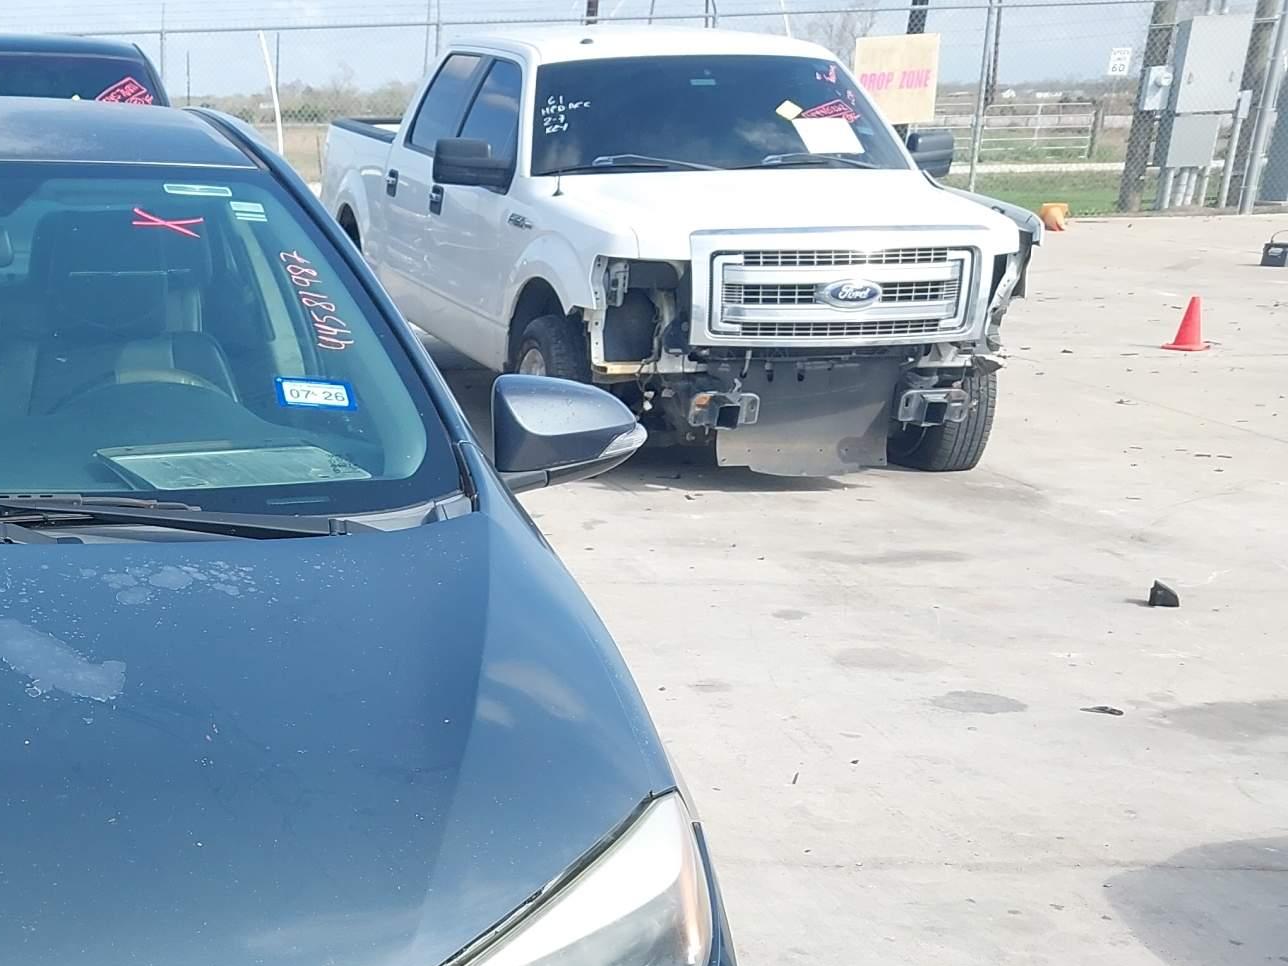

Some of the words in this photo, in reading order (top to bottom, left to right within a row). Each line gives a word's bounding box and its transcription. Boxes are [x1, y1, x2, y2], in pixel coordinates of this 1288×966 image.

[1111, 63, 1125, 72] 60
[859, 72, 895, 92] DROP
[898, 69, 932, 89] ZONE
[279, 250, 355, 350] 44581987
[838, 284, 871, 300] Ford
[289, 387, 312, 400] 07
[321, 390, 346, 402] 26
